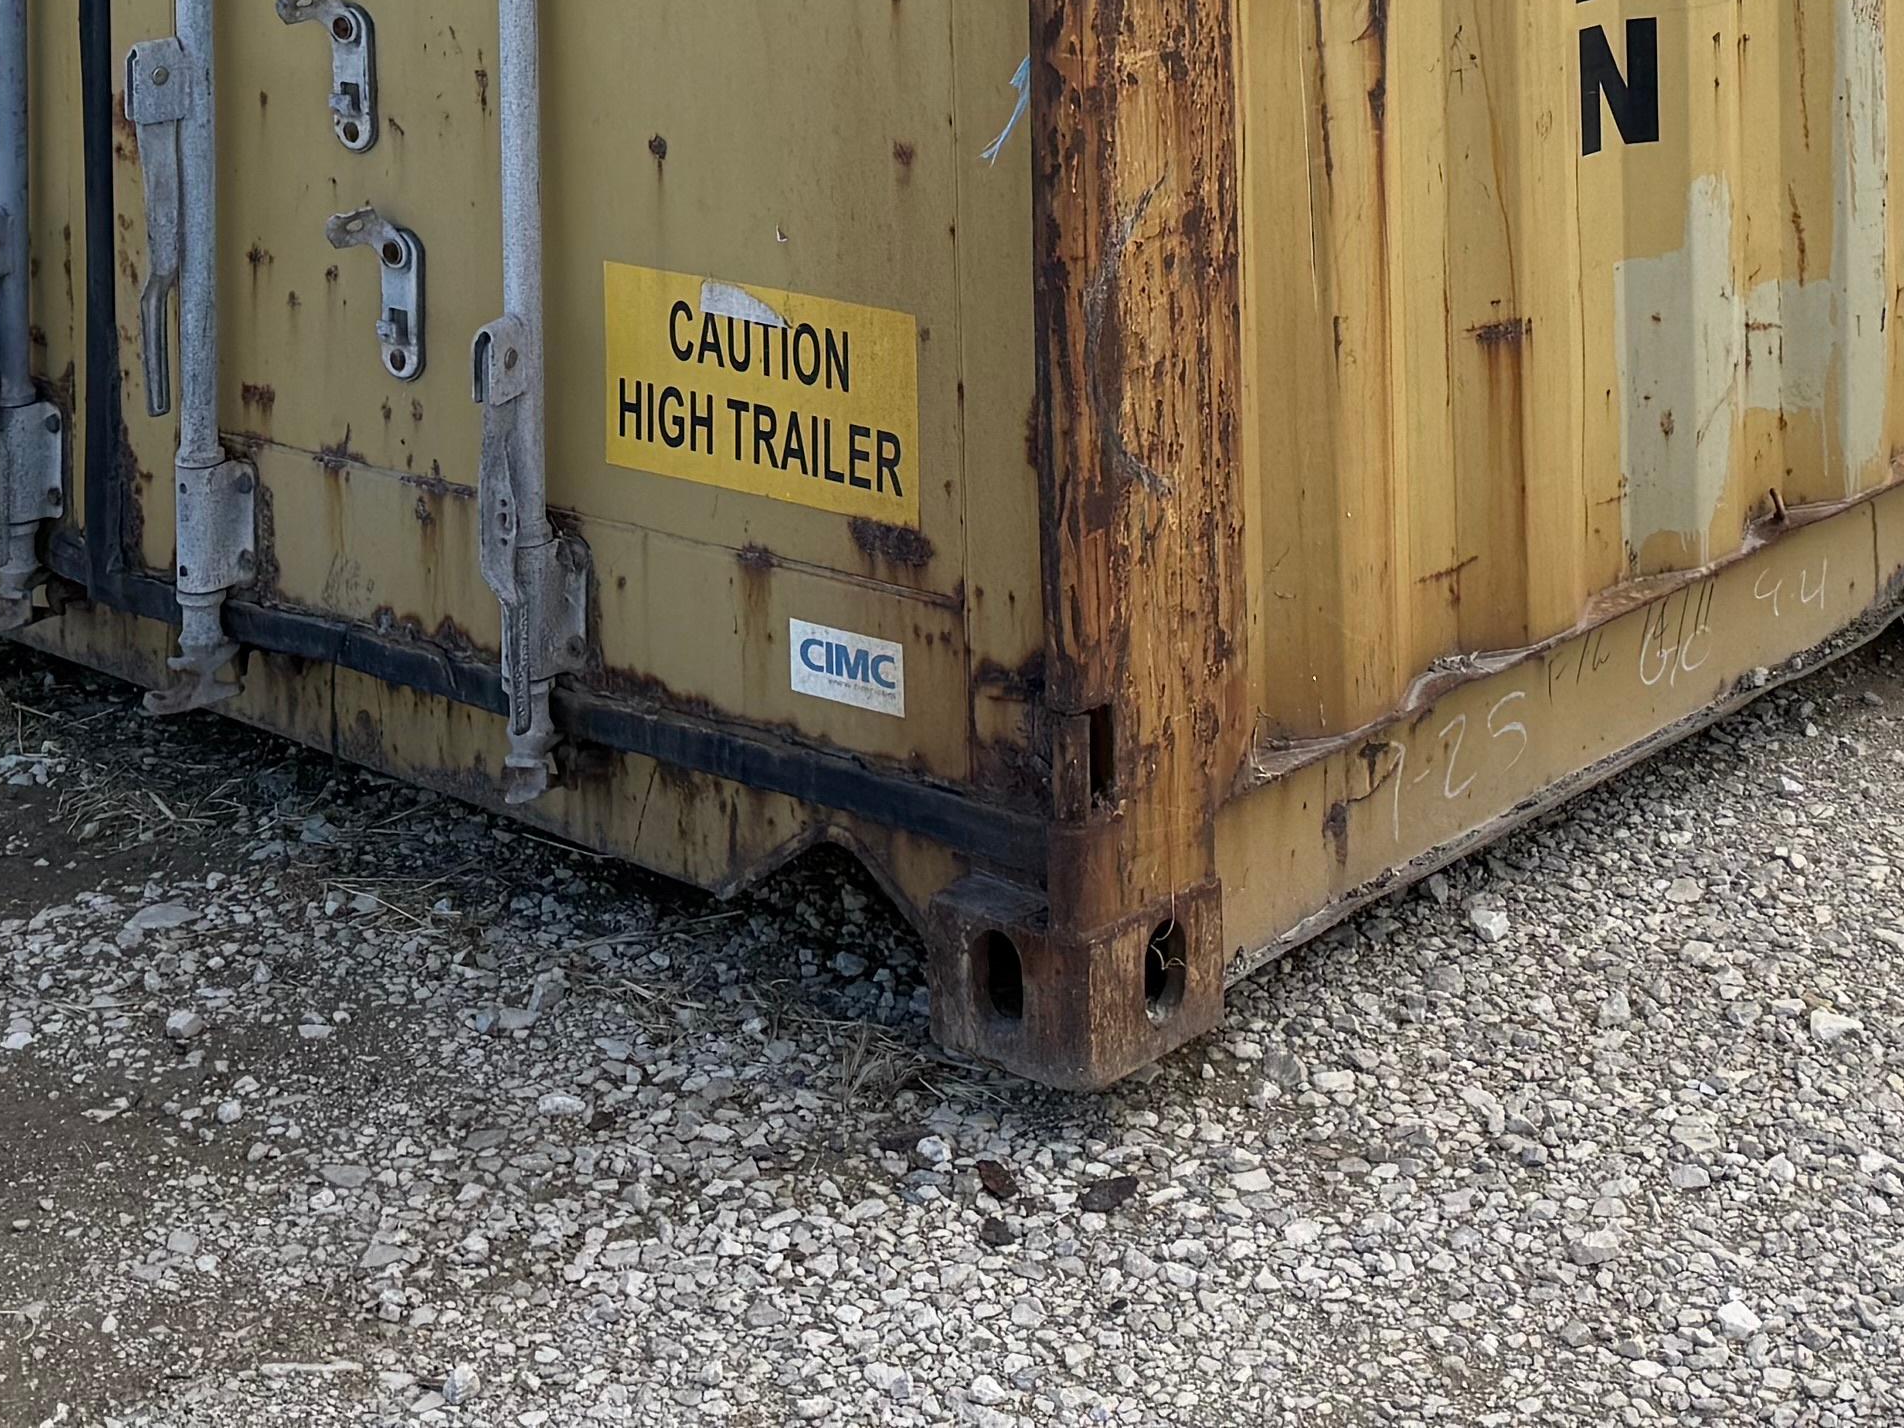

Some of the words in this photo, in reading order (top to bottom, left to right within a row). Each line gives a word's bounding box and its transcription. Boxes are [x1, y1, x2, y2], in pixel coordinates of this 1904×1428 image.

[668, 300, 851, 393] CAUTION
[618, 377, 715, 456] HIGH
[726, 398, 904, 498] TRAILER
[799, 638, 897, 690] CIMC
